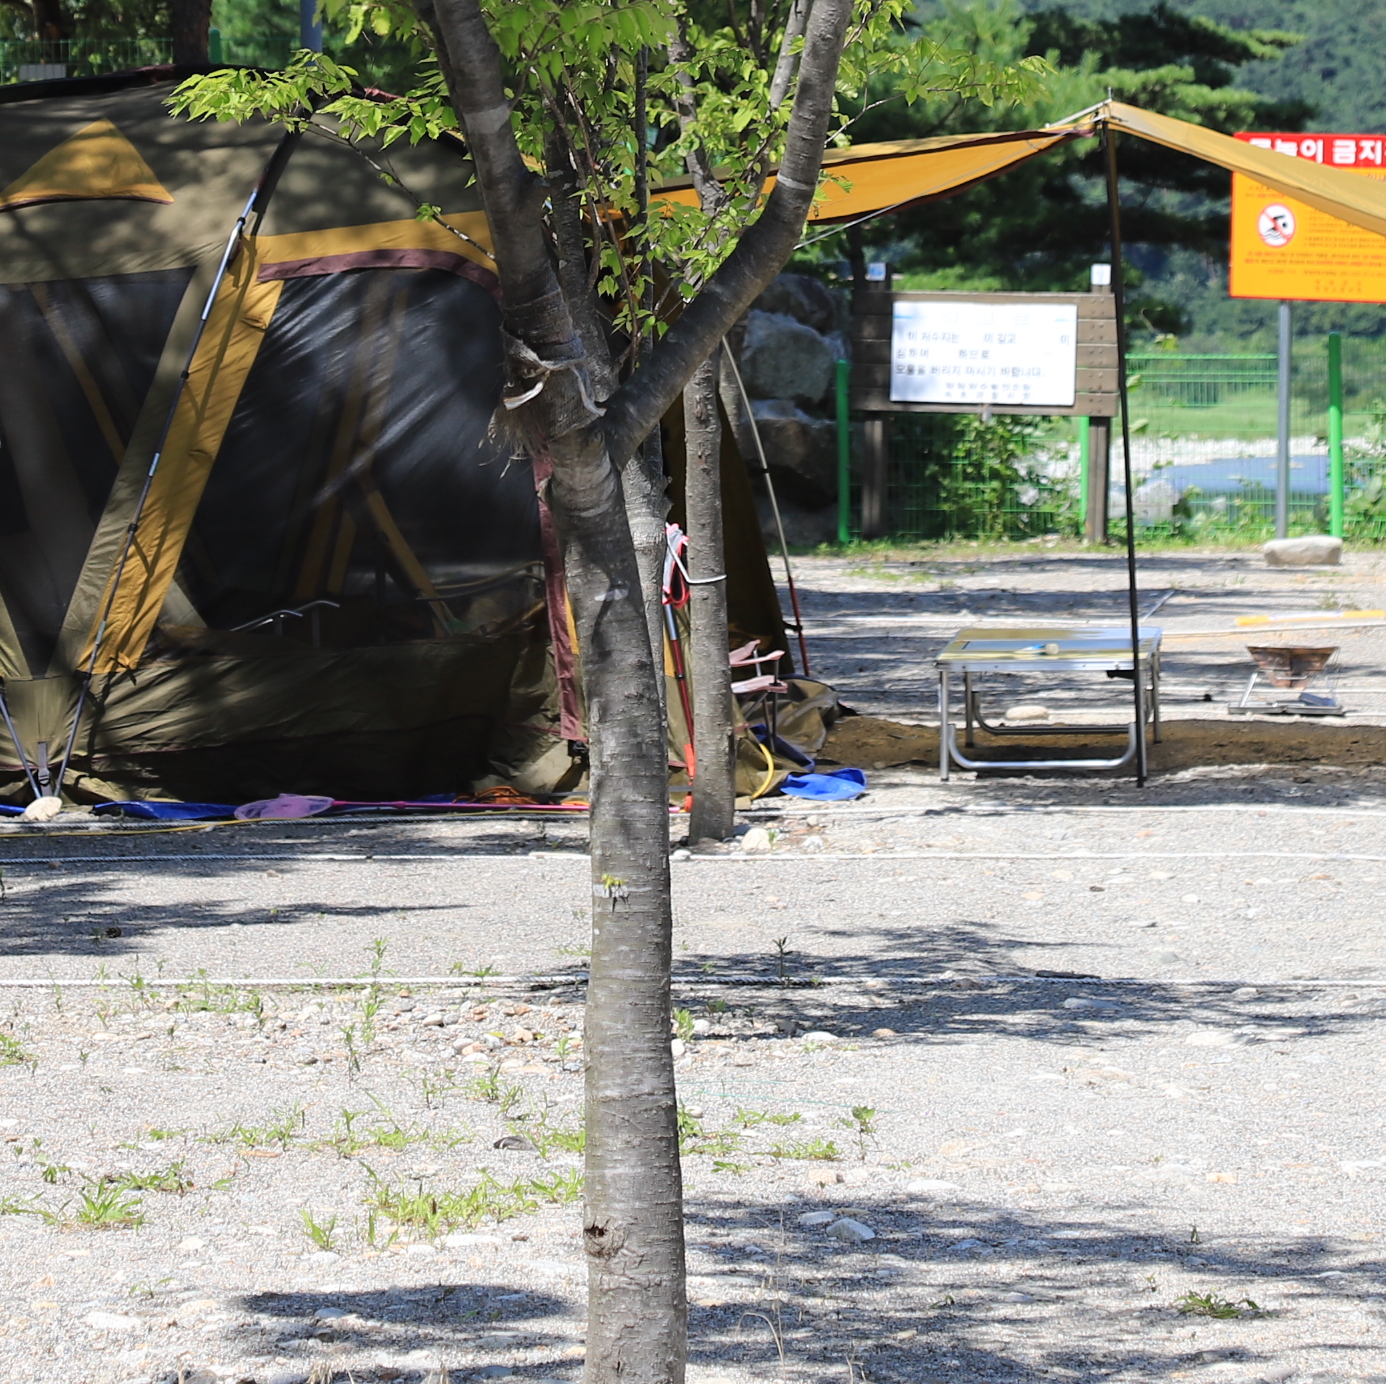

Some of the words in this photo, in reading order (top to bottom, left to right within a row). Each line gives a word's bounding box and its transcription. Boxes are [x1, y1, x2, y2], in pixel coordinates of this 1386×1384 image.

[921, 330, 960, 344] 저수지는
[930, 364, 961, 376] 버리지
[966, 365, 996, 377] 마시기
